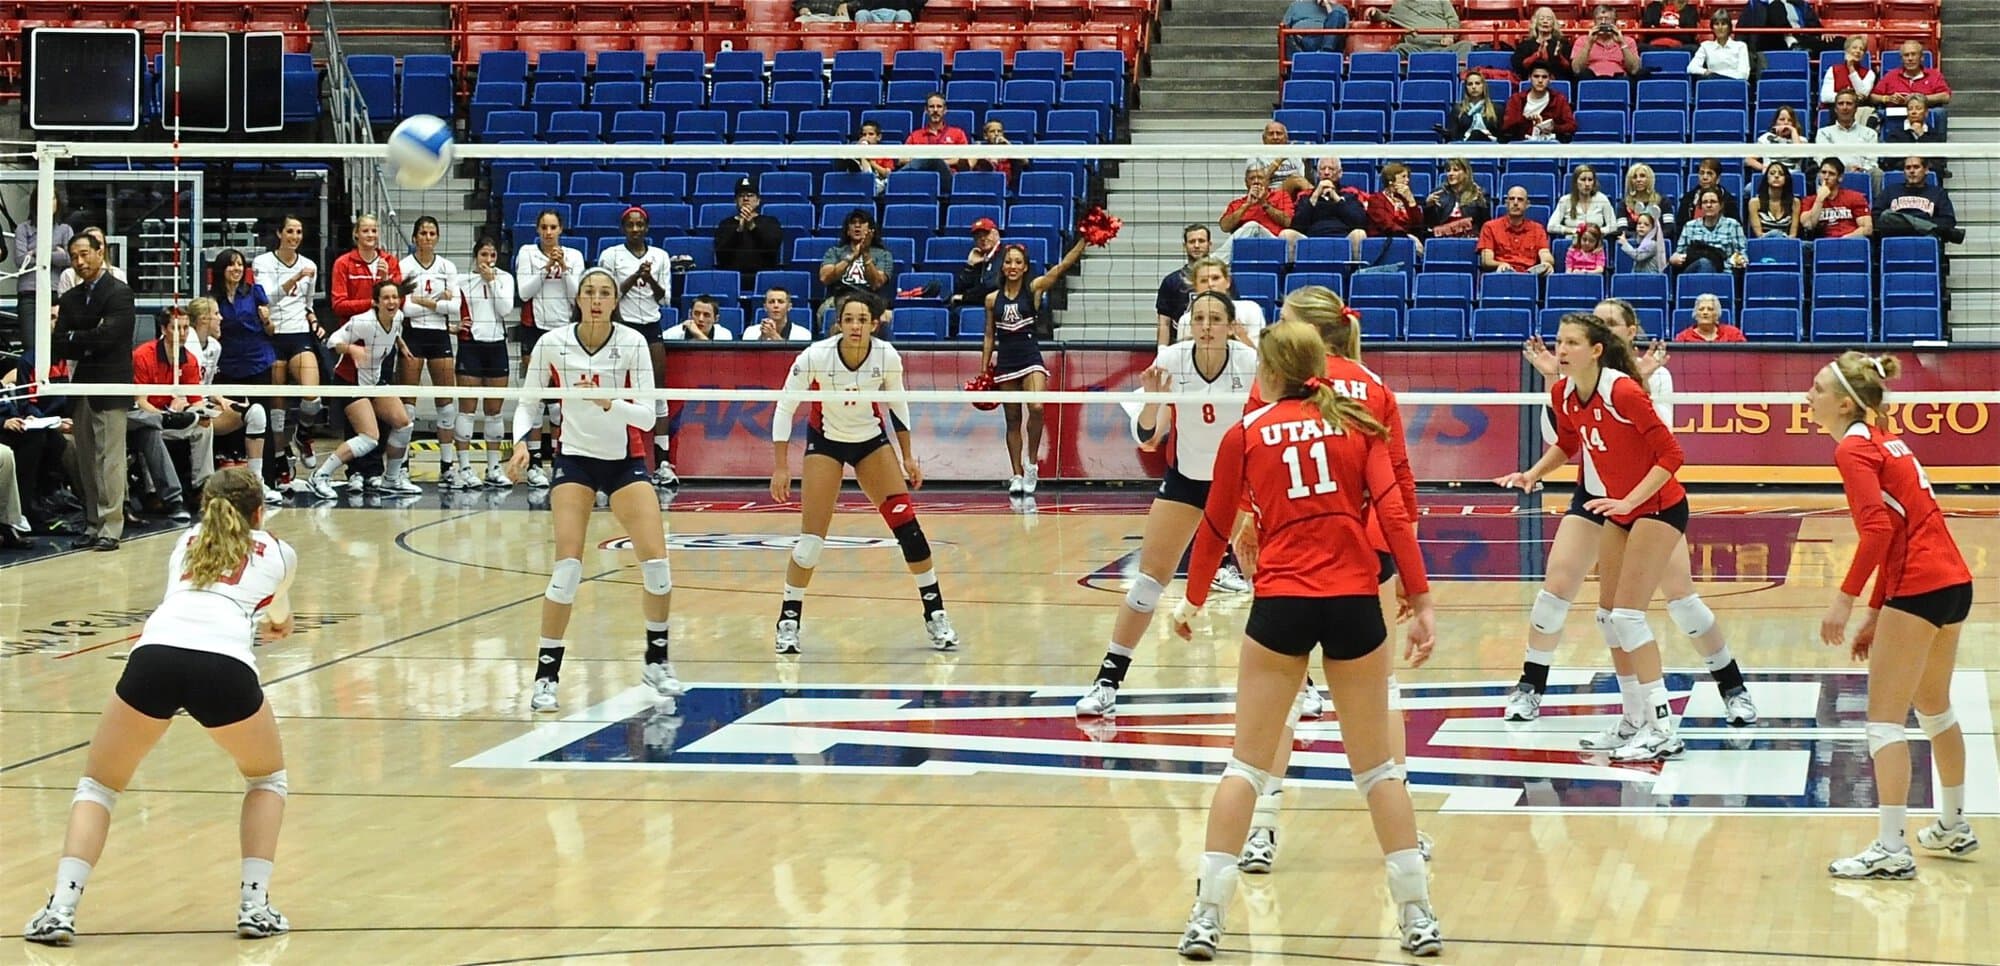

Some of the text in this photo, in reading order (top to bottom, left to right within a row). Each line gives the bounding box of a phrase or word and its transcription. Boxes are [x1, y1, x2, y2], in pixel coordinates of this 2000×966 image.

[424, 280, 432, 295] 4
[483, 284, 488, 299] 1
[1332, 379, 1368, 400] AH
[1202, 403, 1216, 424] 8
[1580, 425, 1608, 451] 14
[1282, 441, 1338, 499] 11
